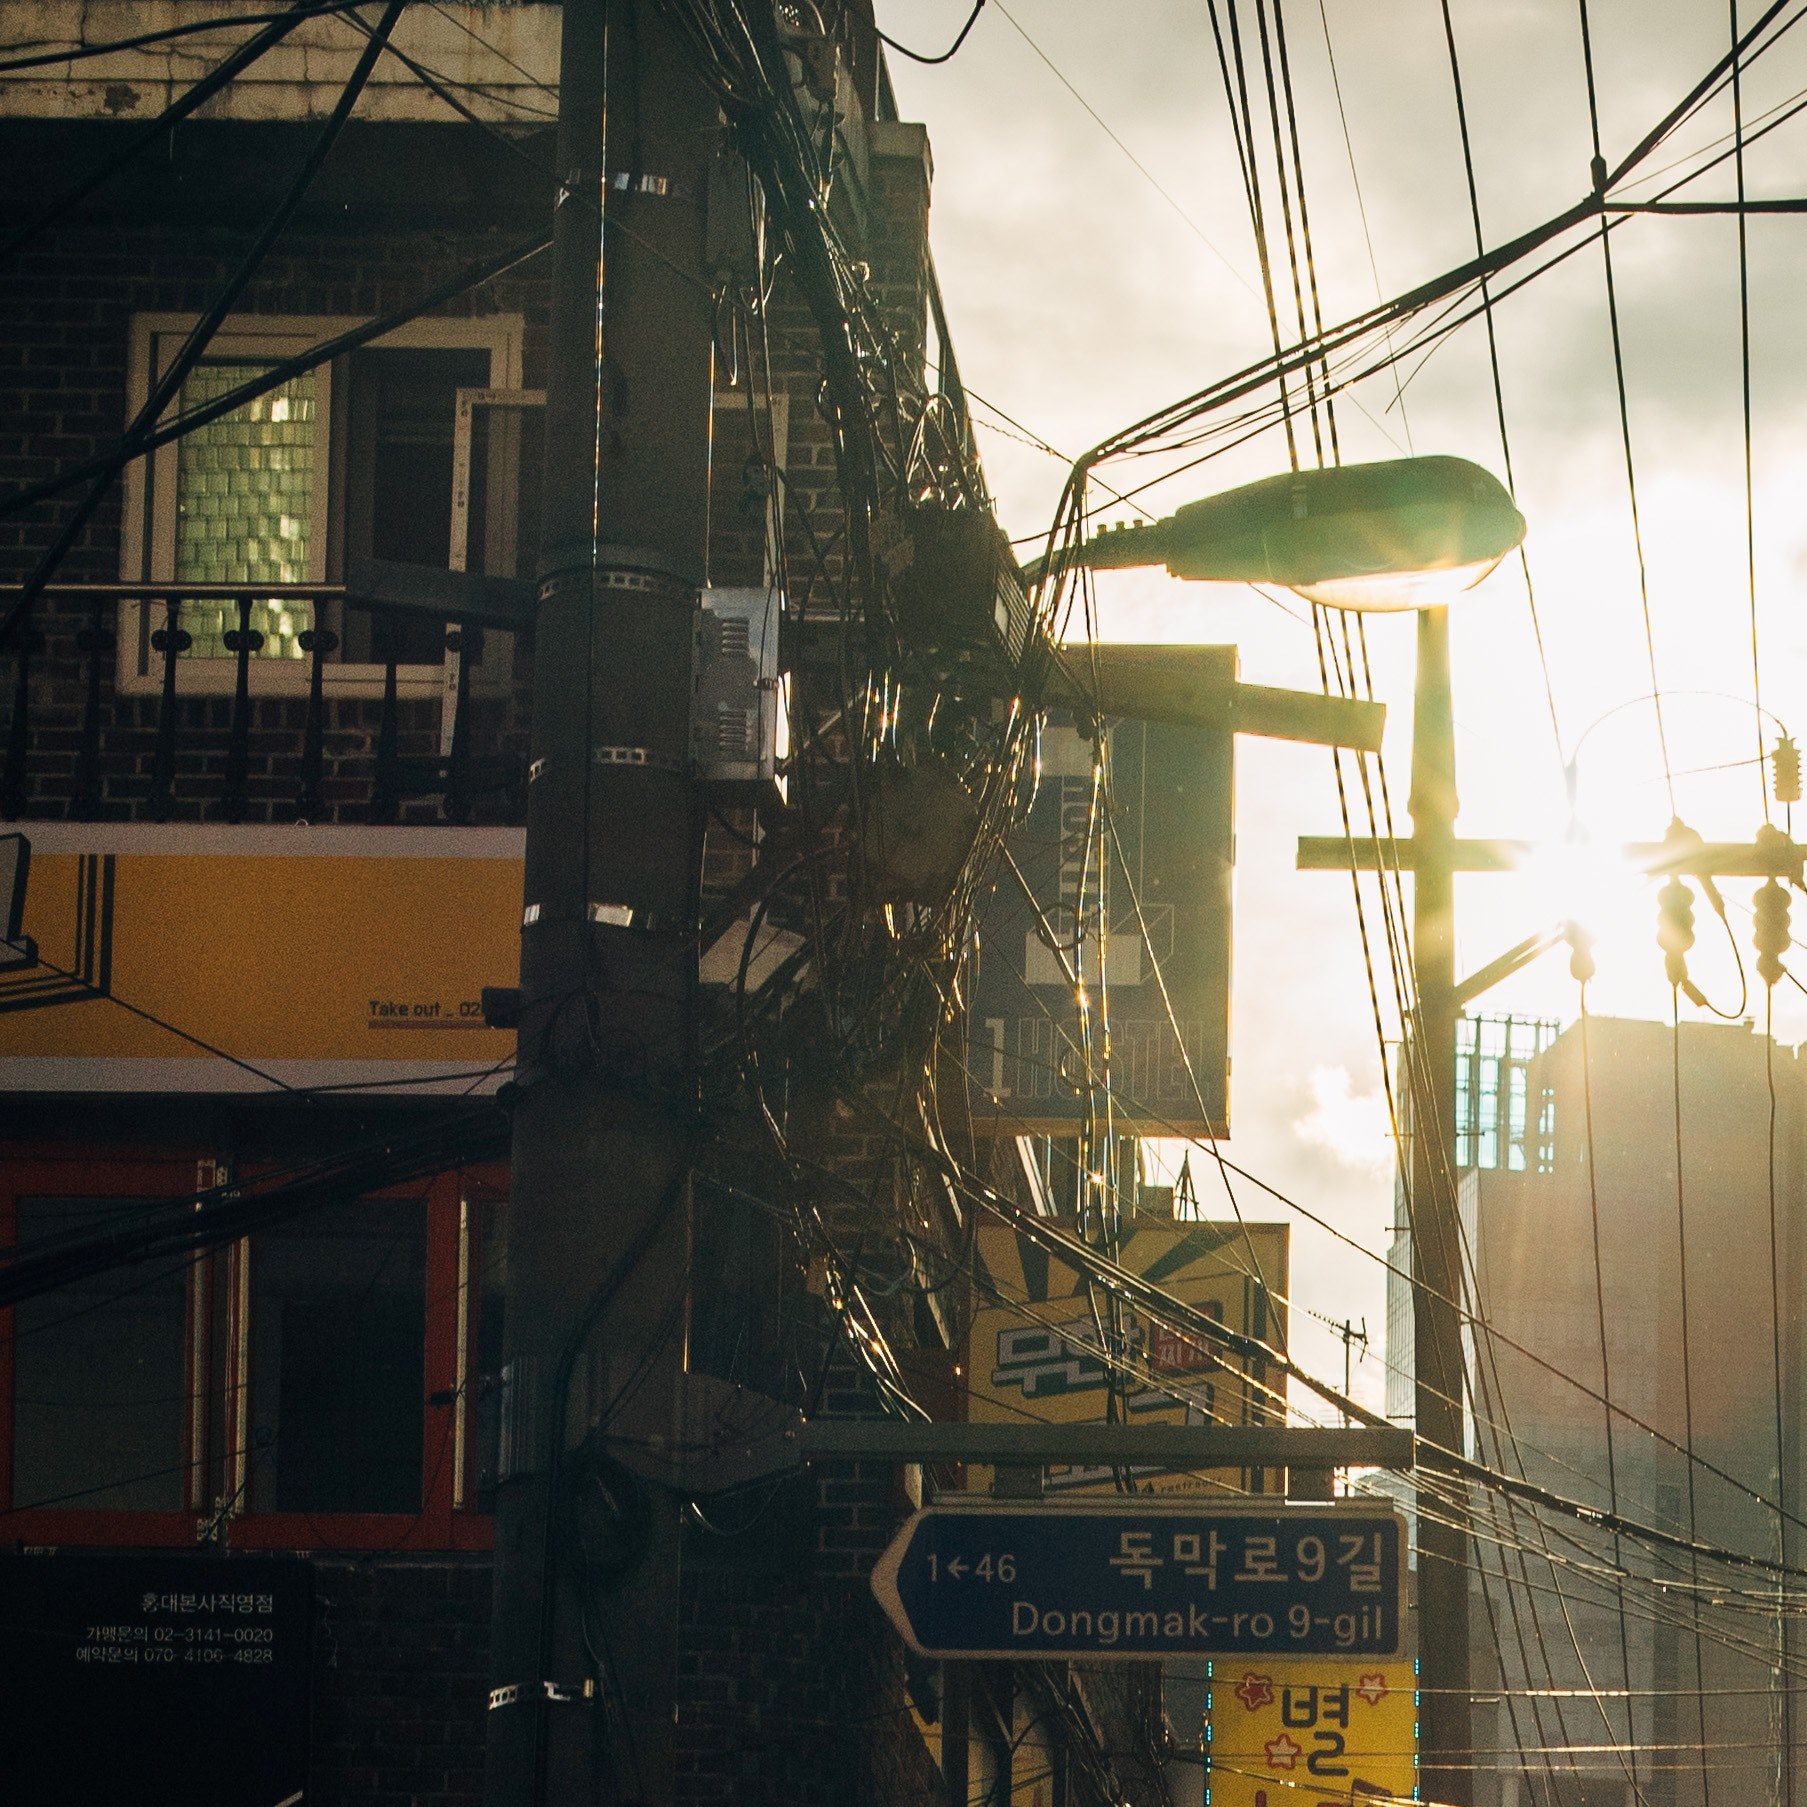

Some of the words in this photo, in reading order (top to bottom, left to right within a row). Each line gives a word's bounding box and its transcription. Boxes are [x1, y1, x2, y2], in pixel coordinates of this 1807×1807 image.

[369, 1000, 409, 1017] Take
[413, 1001, 441, 1017] out
[1109, 1530, 1383, 1592] 독막로9길
[1011, 1602, 1275, 1645] Dongmak-ro
[1288, 1602, 1383, 1647] 9-gil
